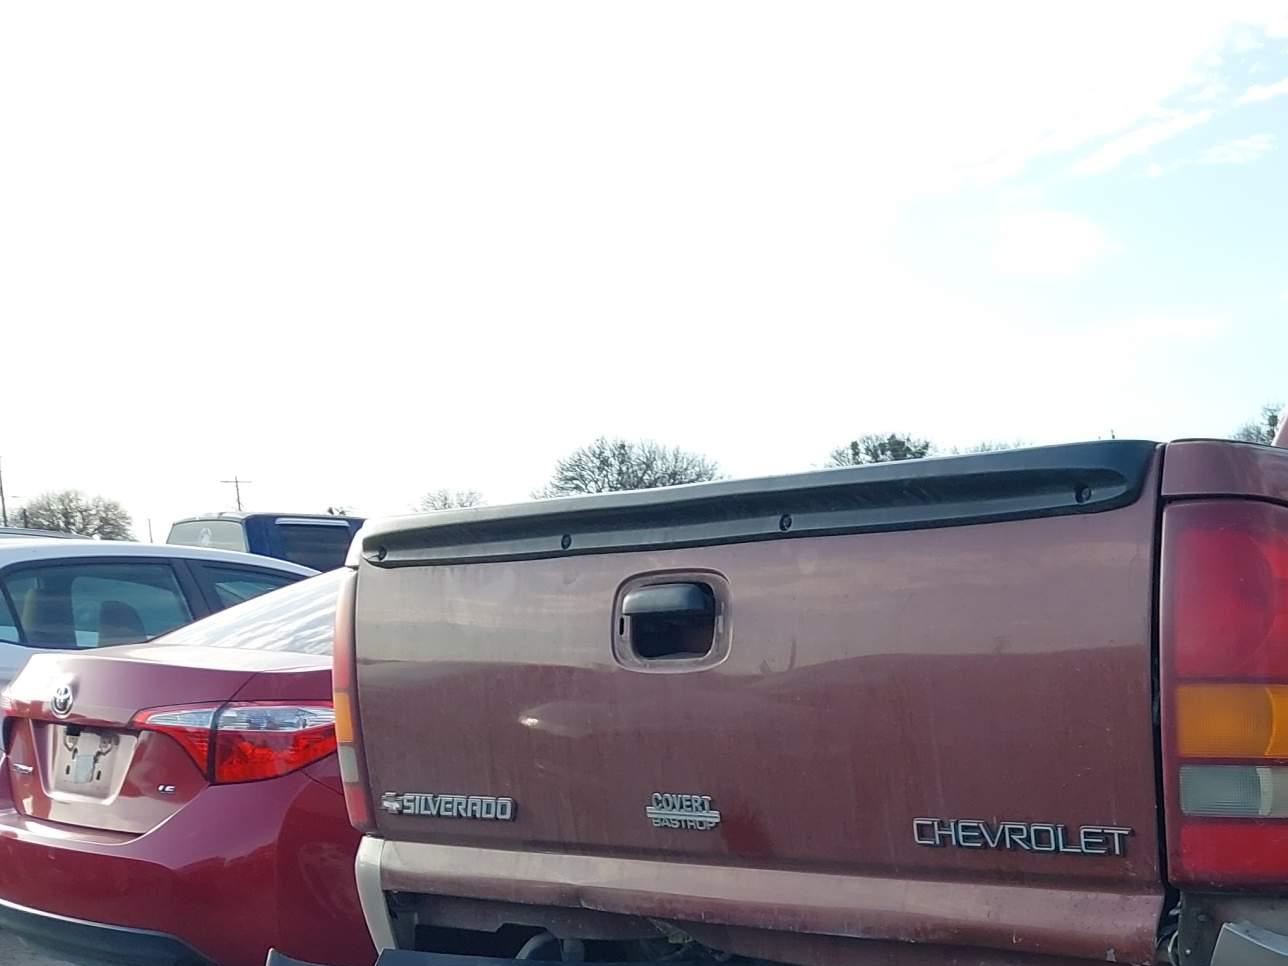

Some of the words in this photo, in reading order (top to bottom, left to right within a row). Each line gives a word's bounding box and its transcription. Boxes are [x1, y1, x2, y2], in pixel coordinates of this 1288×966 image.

[402, 793, 514, 820] SILVERADO
[652, 792, 712, 812] COVERT
[912, 817, 1132, 855] CHEVROLET
